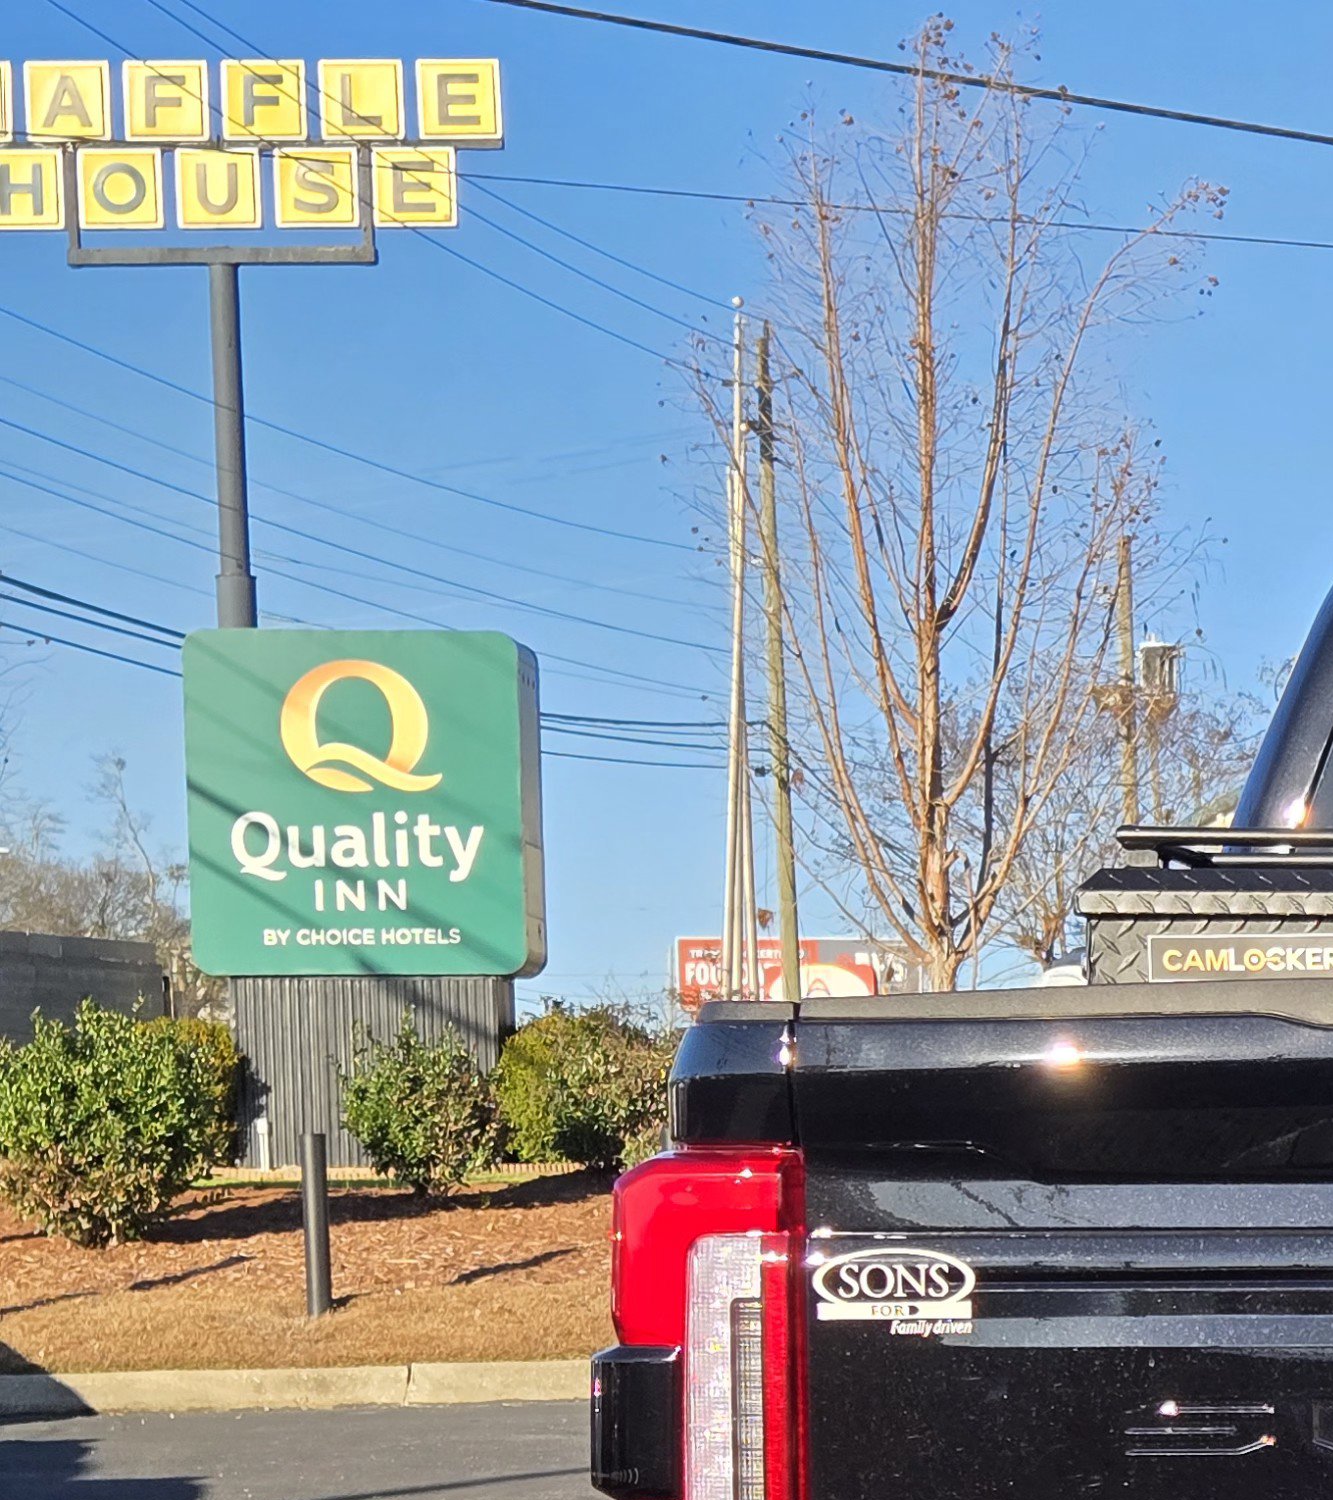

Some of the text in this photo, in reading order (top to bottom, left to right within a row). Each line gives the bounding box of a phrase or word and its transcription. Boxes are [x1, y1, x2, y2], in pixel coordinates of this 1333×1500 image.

[0, 73, 481, 128] AFFLE
[0, 161, 437, 215] HOUSE
[280, 659, 443, 792] Q
[230, 810, 485, 883] Quality
[314, 878, 408, 912] INN
[263, 927, 462, 946] BY CHOICE HOTELS
[837, 1263, 952, 1299] SONS
[870, 1304, 920, 1317] FORD
[889, 1319, 974, 1338] Family driven
